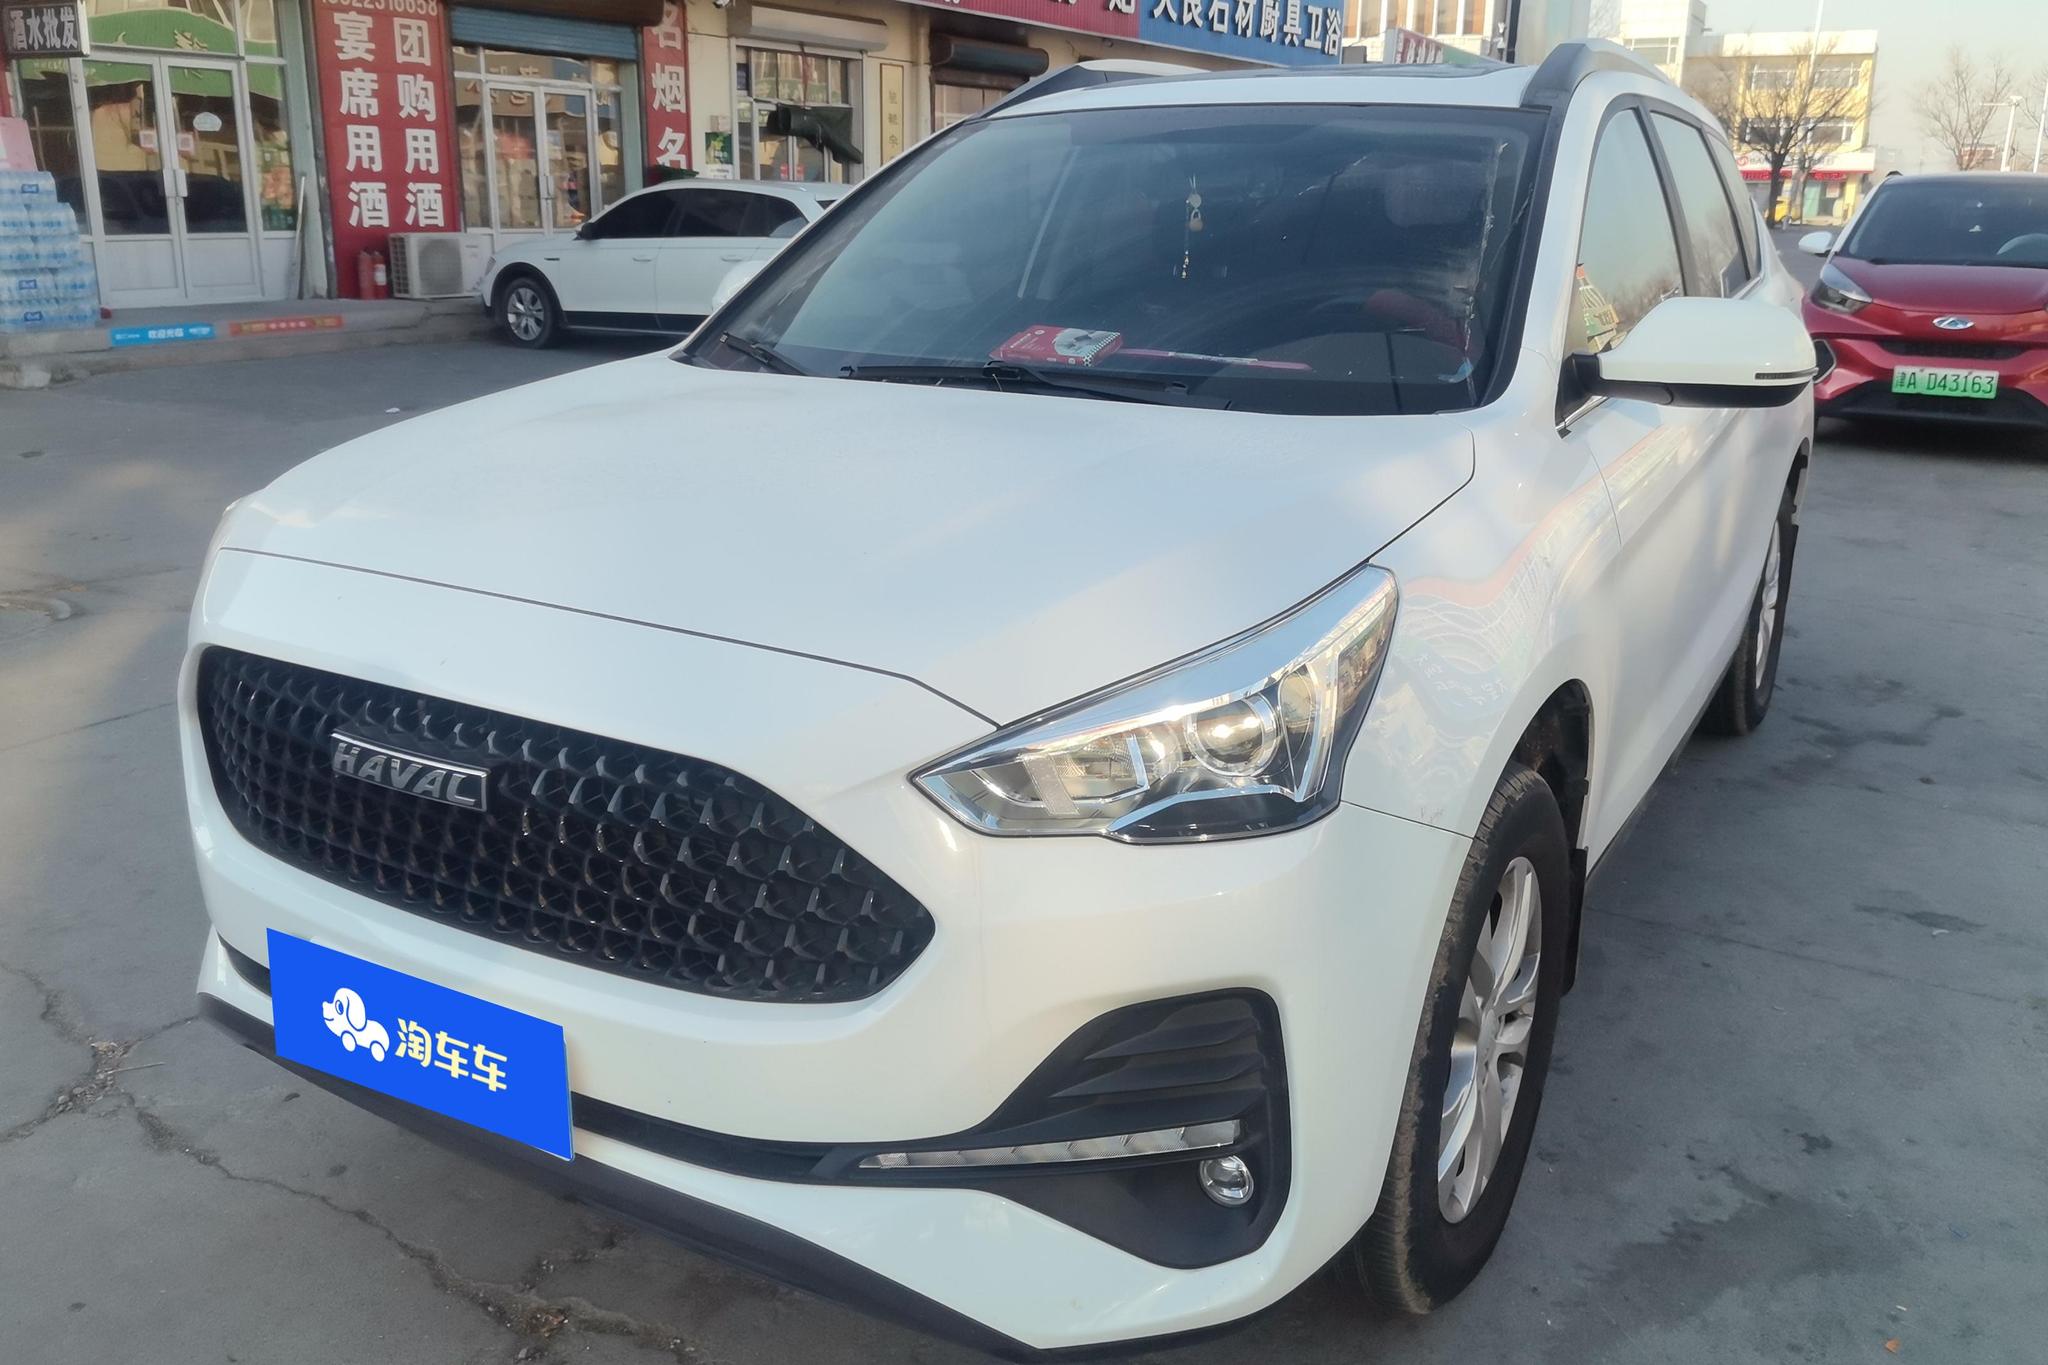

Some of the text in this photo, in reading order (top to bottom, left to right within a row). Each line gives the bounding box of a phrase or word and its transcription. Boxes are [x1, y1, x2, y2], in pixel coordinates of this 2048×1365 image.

[9, 6, 78, 50] 酒水批发
[333, 11, 390, 229] 宴席用酒
[393, 17, 445, 228] 团购用酒
[332, 742, 476, 806] HAVAL
